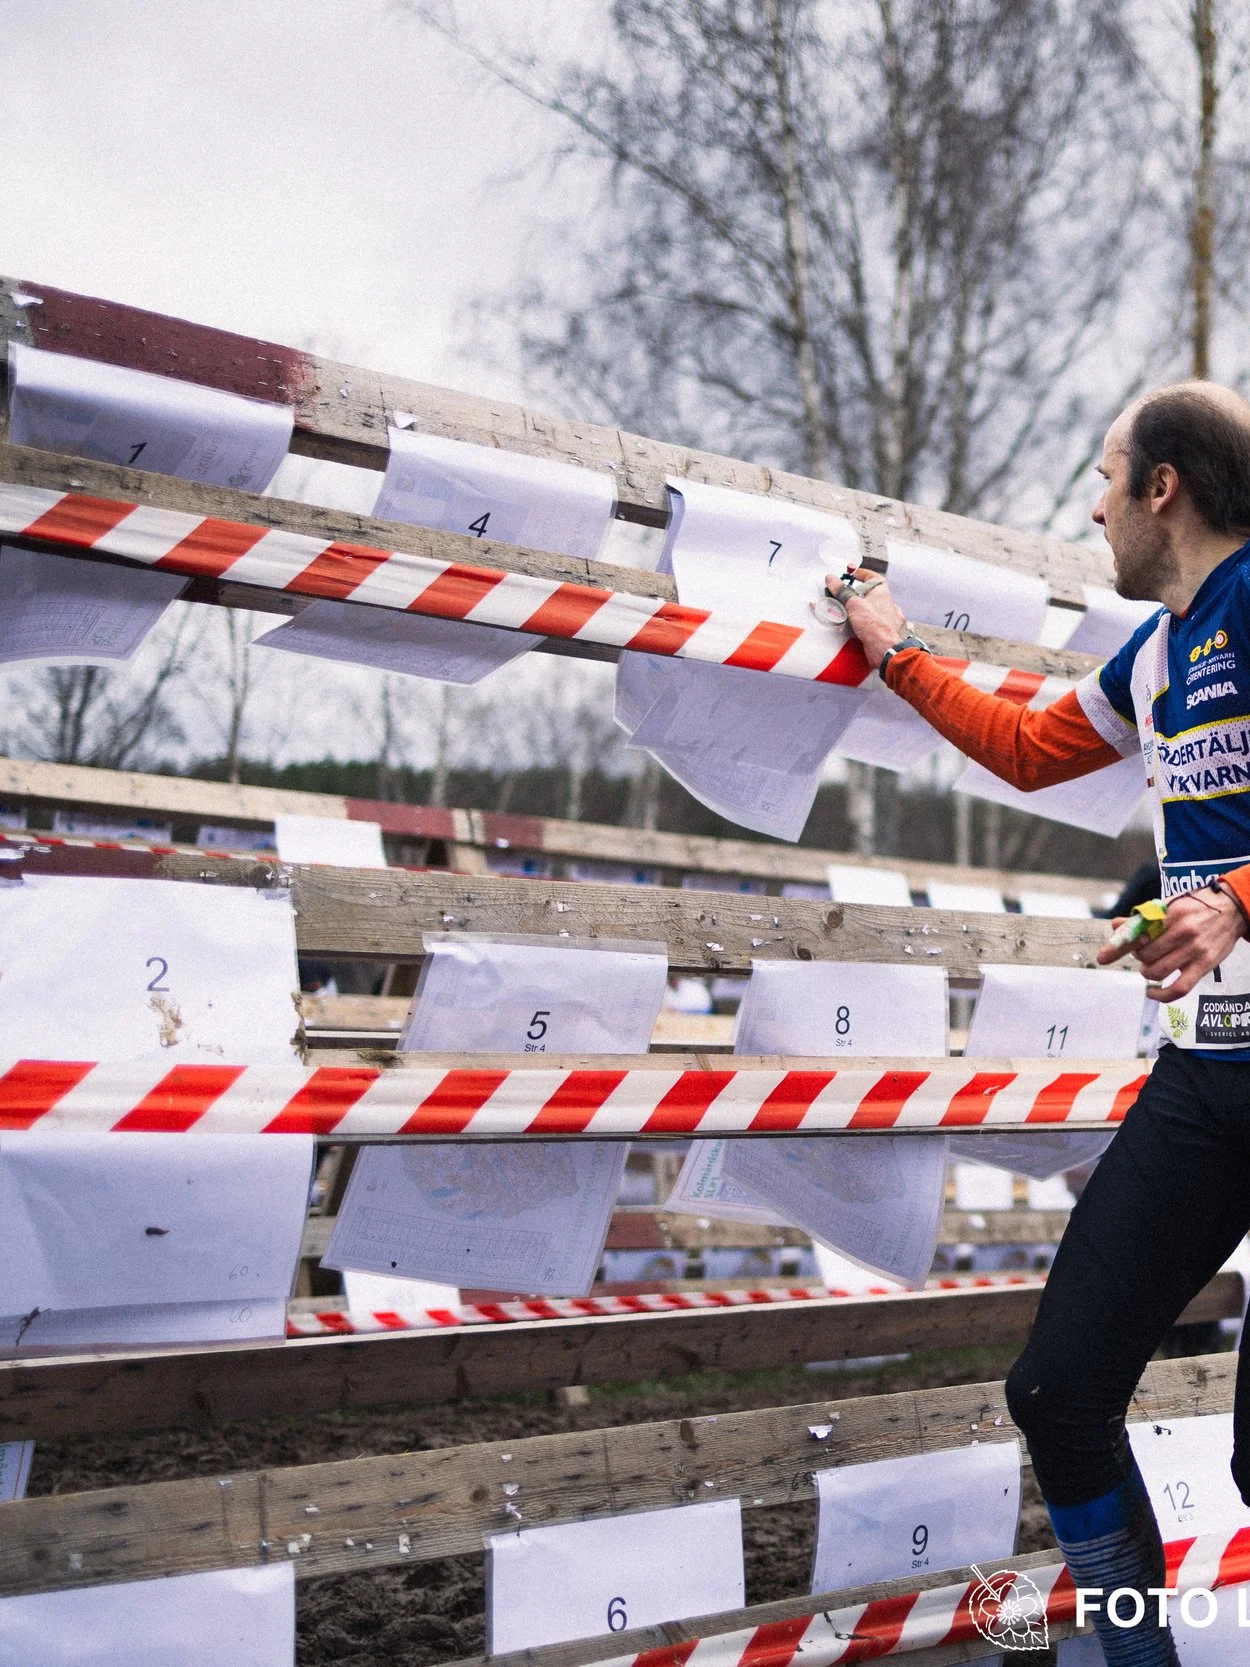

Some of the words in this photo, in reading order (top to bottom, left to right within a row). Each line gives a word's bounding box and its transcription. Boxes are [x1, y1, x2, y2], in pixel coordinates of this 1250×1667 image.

[128, 442, 148, 465] 1
[468, 512, 491, 538] 4
[768, 540, 783, 567] 7
[944, 610, 970, 631] 10
[1186, 681, 1239, 709] SCANIA
[146, 957, 169, 992] 2
[527, 1011, 551, 1040] 5
[835, 1005, 850, 1035] 8
[524, 1043, 538, 1052] Str
[539, 1043, 546, 1052] 4
[1046, 1024, 1068, 1050] 11
[1163, 1481, 1194, 1511] 12
[911, 1524, 929, 1556] 9
[911, 1559, 923, 1569] Str
[923, 1556, 929, 1566] 4
[608, 1597, 627, 1631] 6
